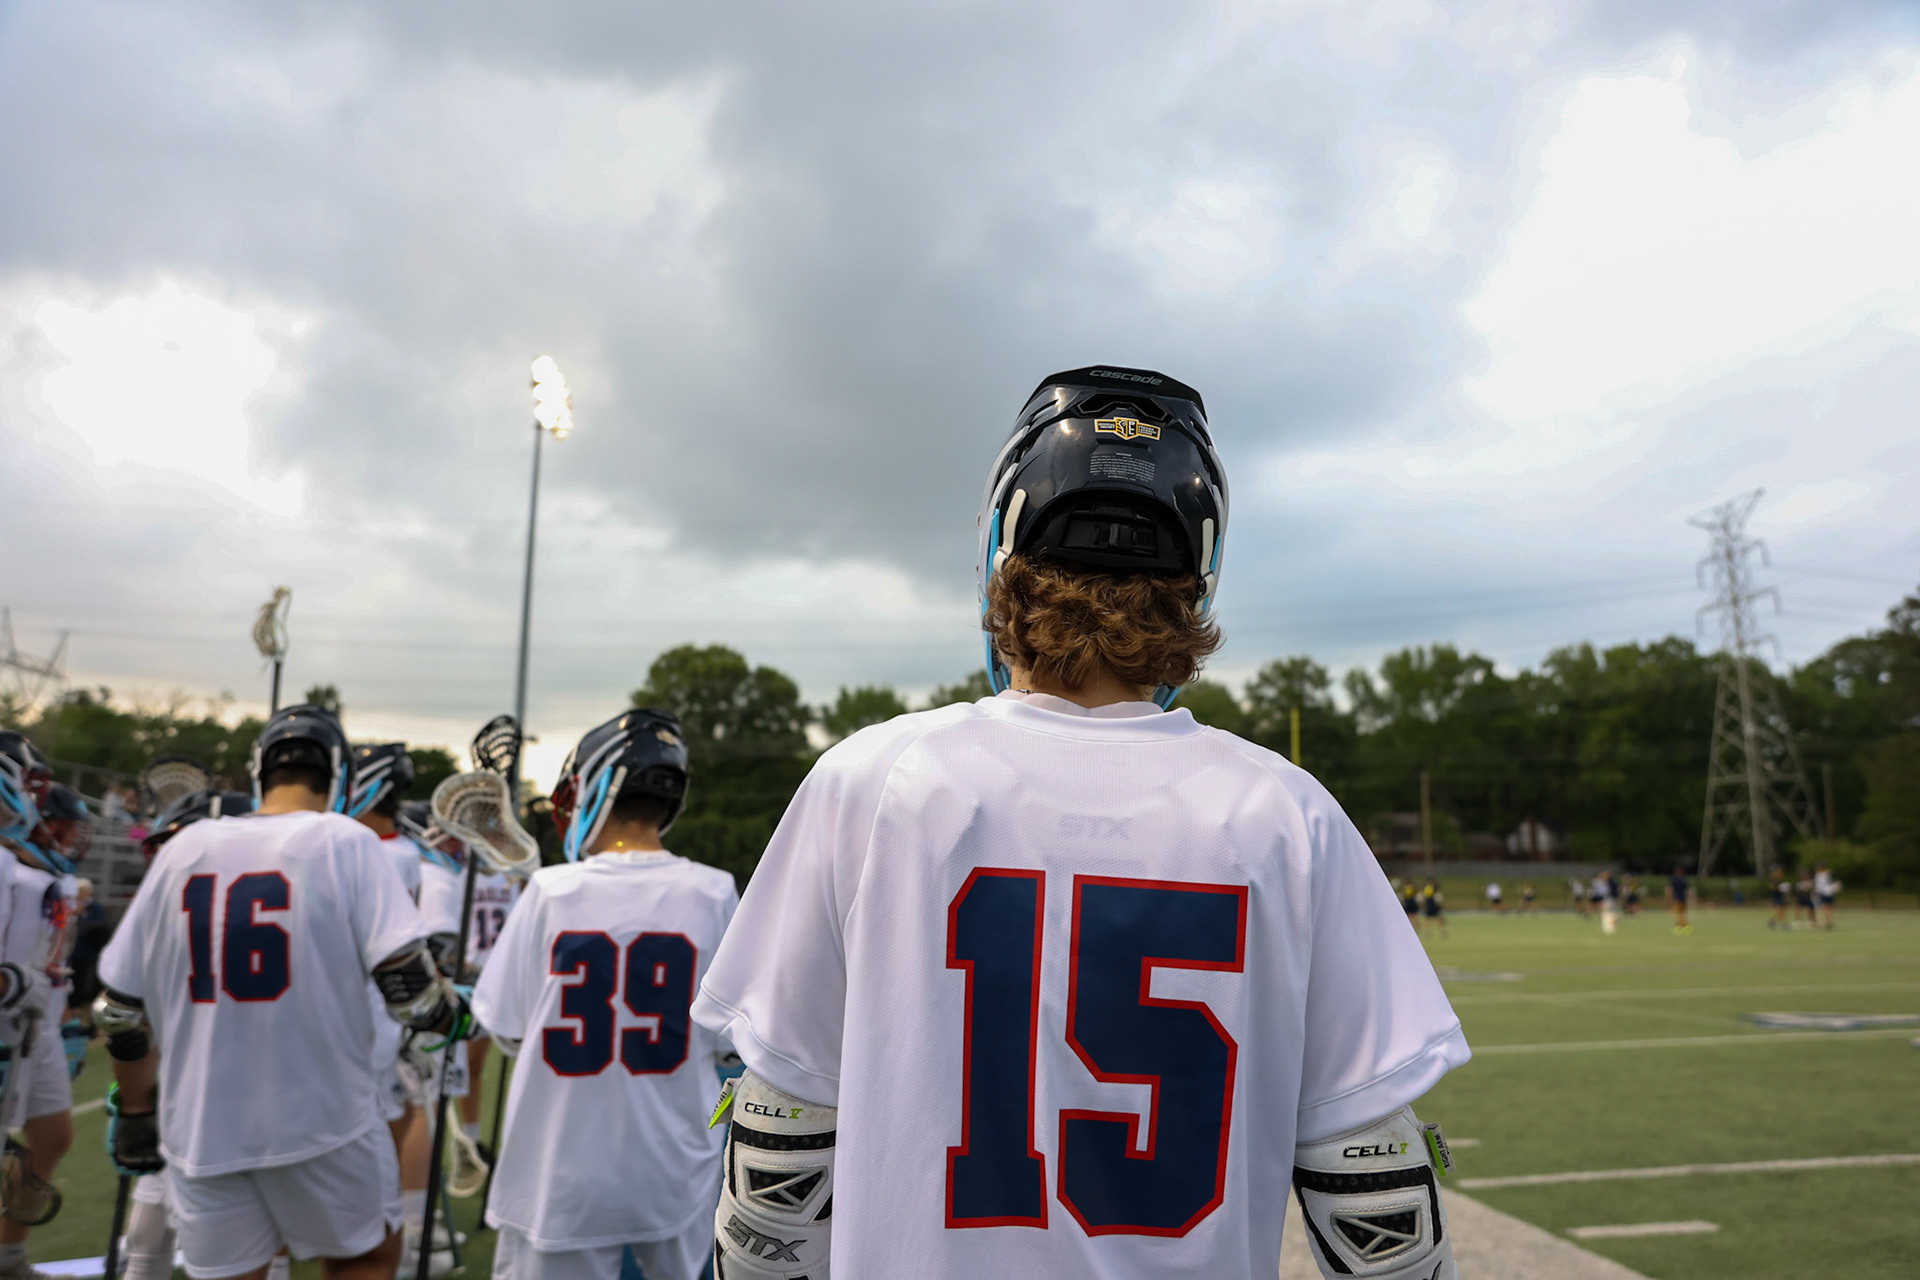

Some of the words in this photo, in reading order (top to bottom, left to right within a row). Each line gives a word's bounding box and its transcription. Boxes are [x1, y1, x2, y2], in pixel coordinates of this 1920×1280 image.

[1089, 370, 1162, 385] cascade
[182, 870, 292, 1004] 16
[542, 930, 698, 1076] 39
[945, 866, 1249, 1238] 15
[744, 1102, 788, 1118] CELL
[1343, 1143, 1398, 1158] CELL
[724, 1214, 807, 1262] STX
